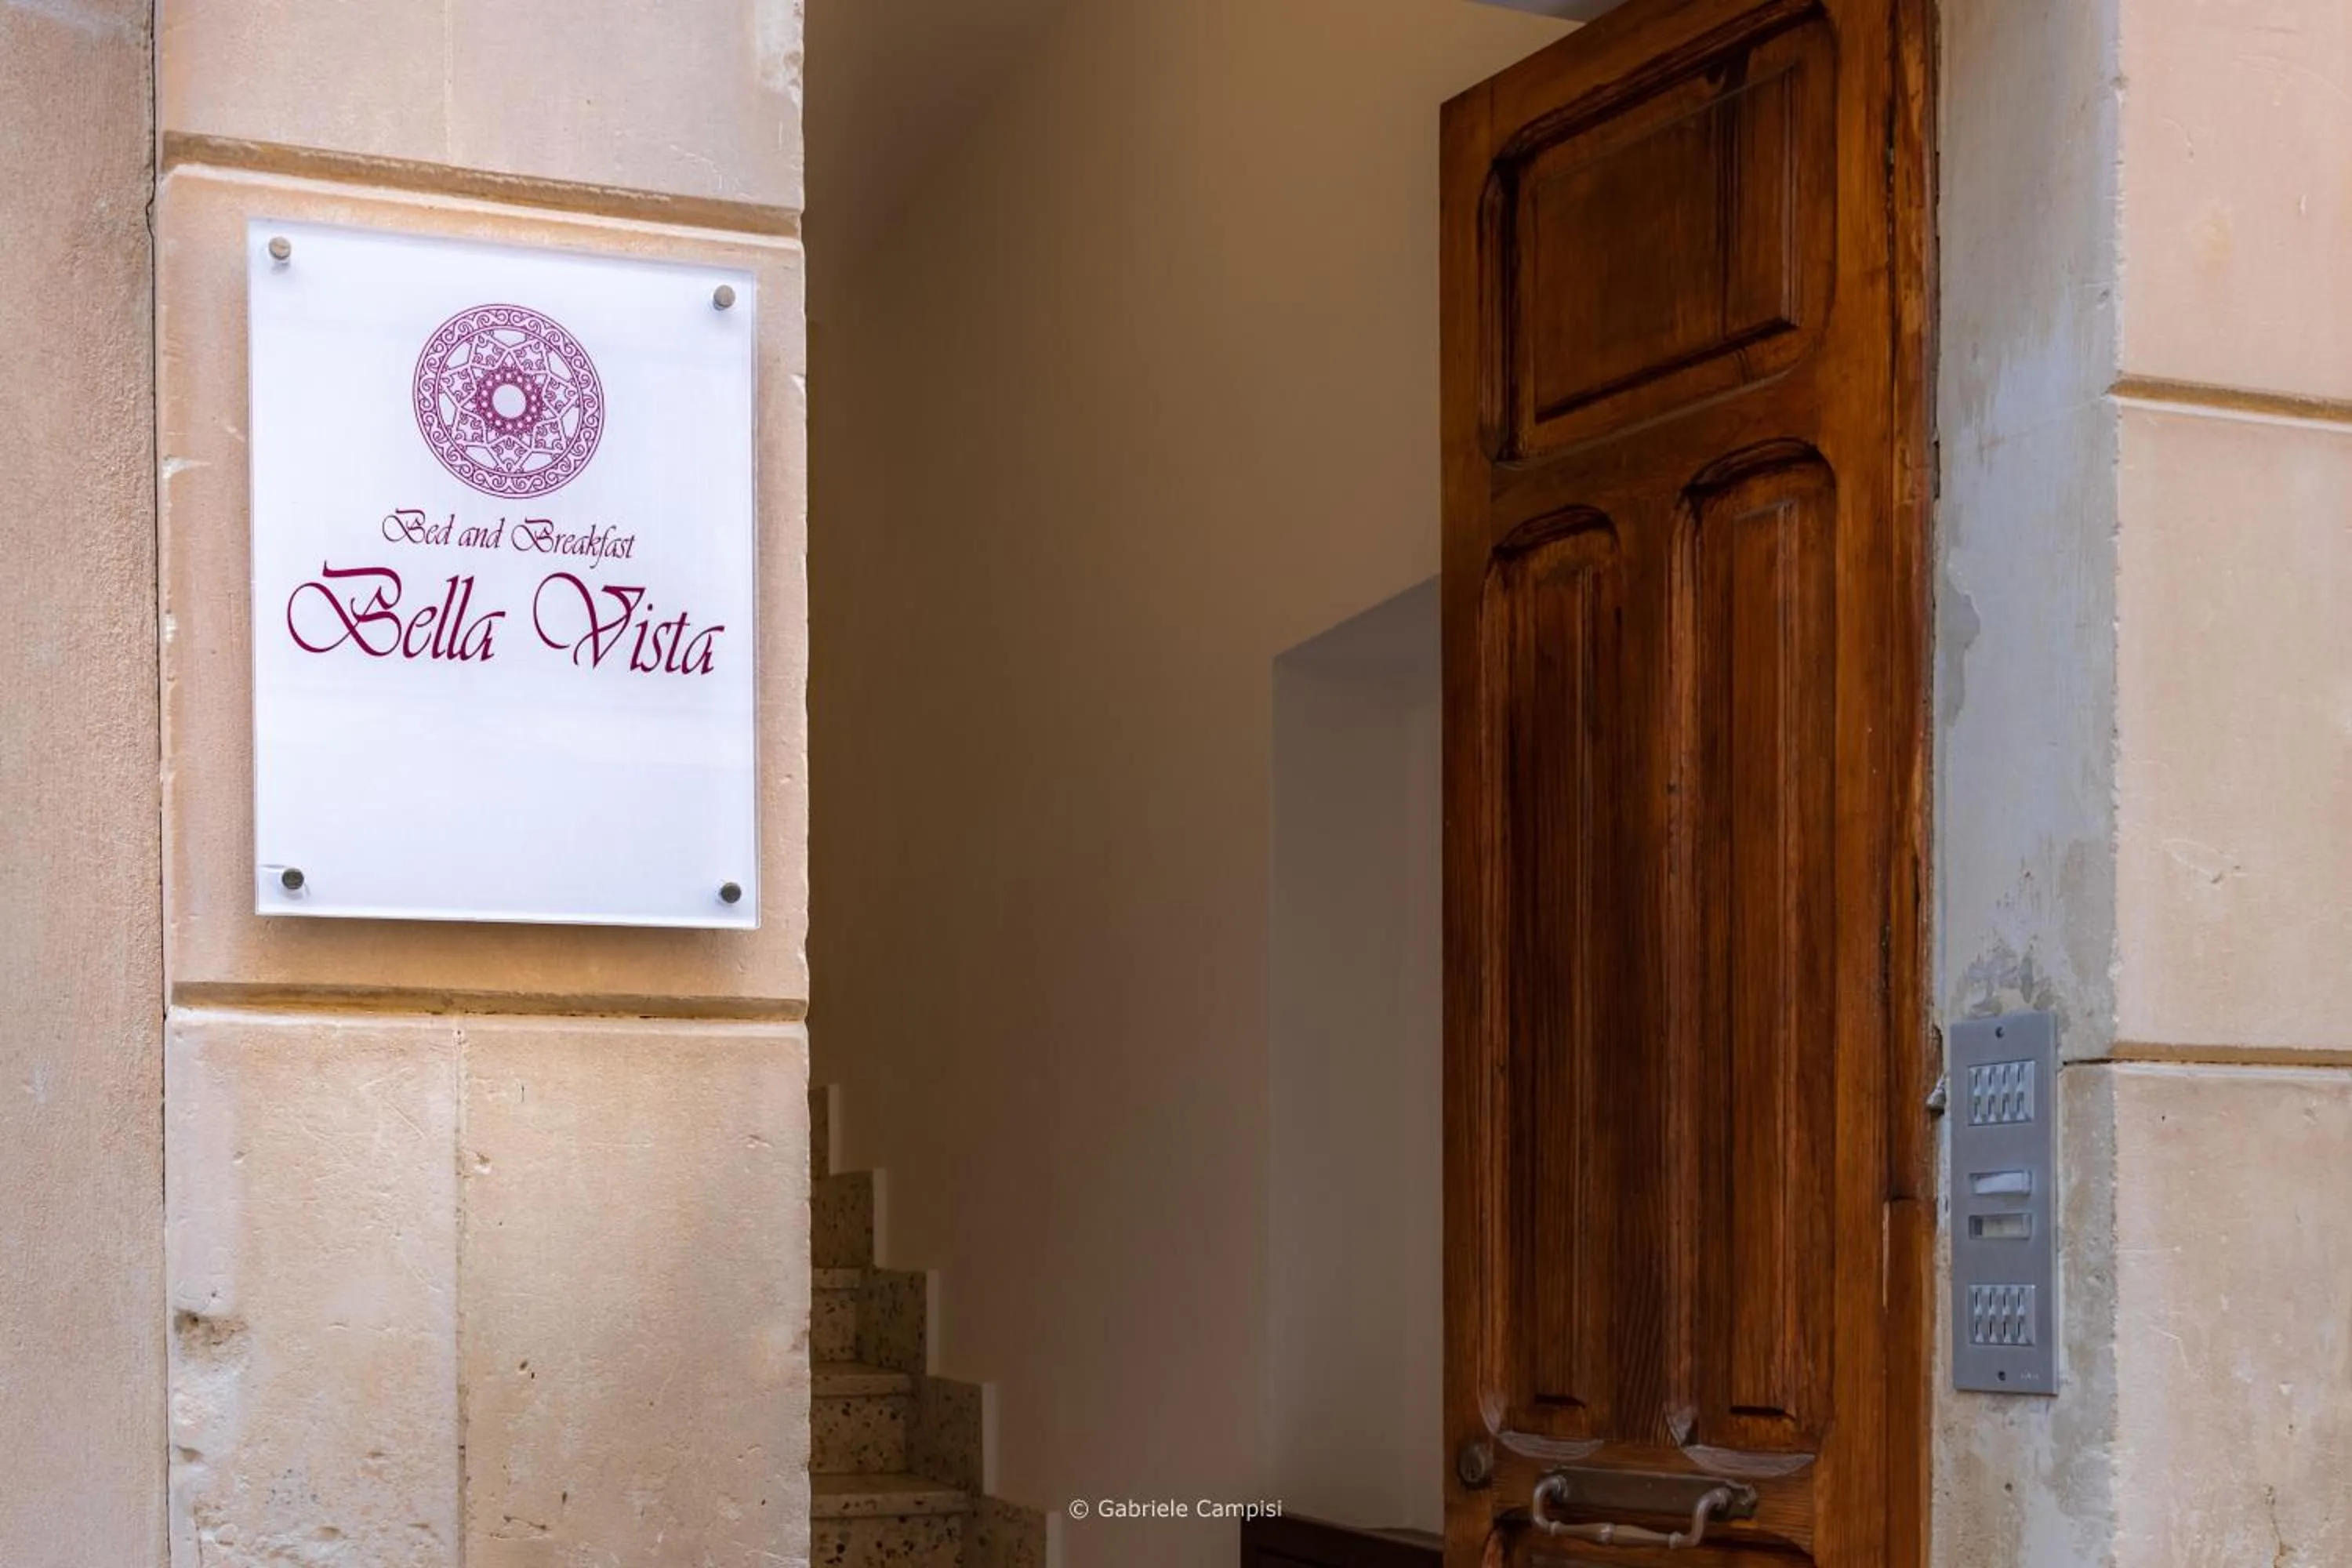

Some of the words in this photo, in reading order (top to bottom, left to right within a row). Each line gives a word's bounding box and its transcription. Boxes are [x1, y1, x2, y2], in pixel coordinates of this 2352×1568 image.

[382, 507, 454, 545] Bed
[457, 517, 506, 550] and
[510, 516, 637, 570] Breakfast
[286, 560, 506, 662] Bella
[532, 572, 725, 675] Vista
